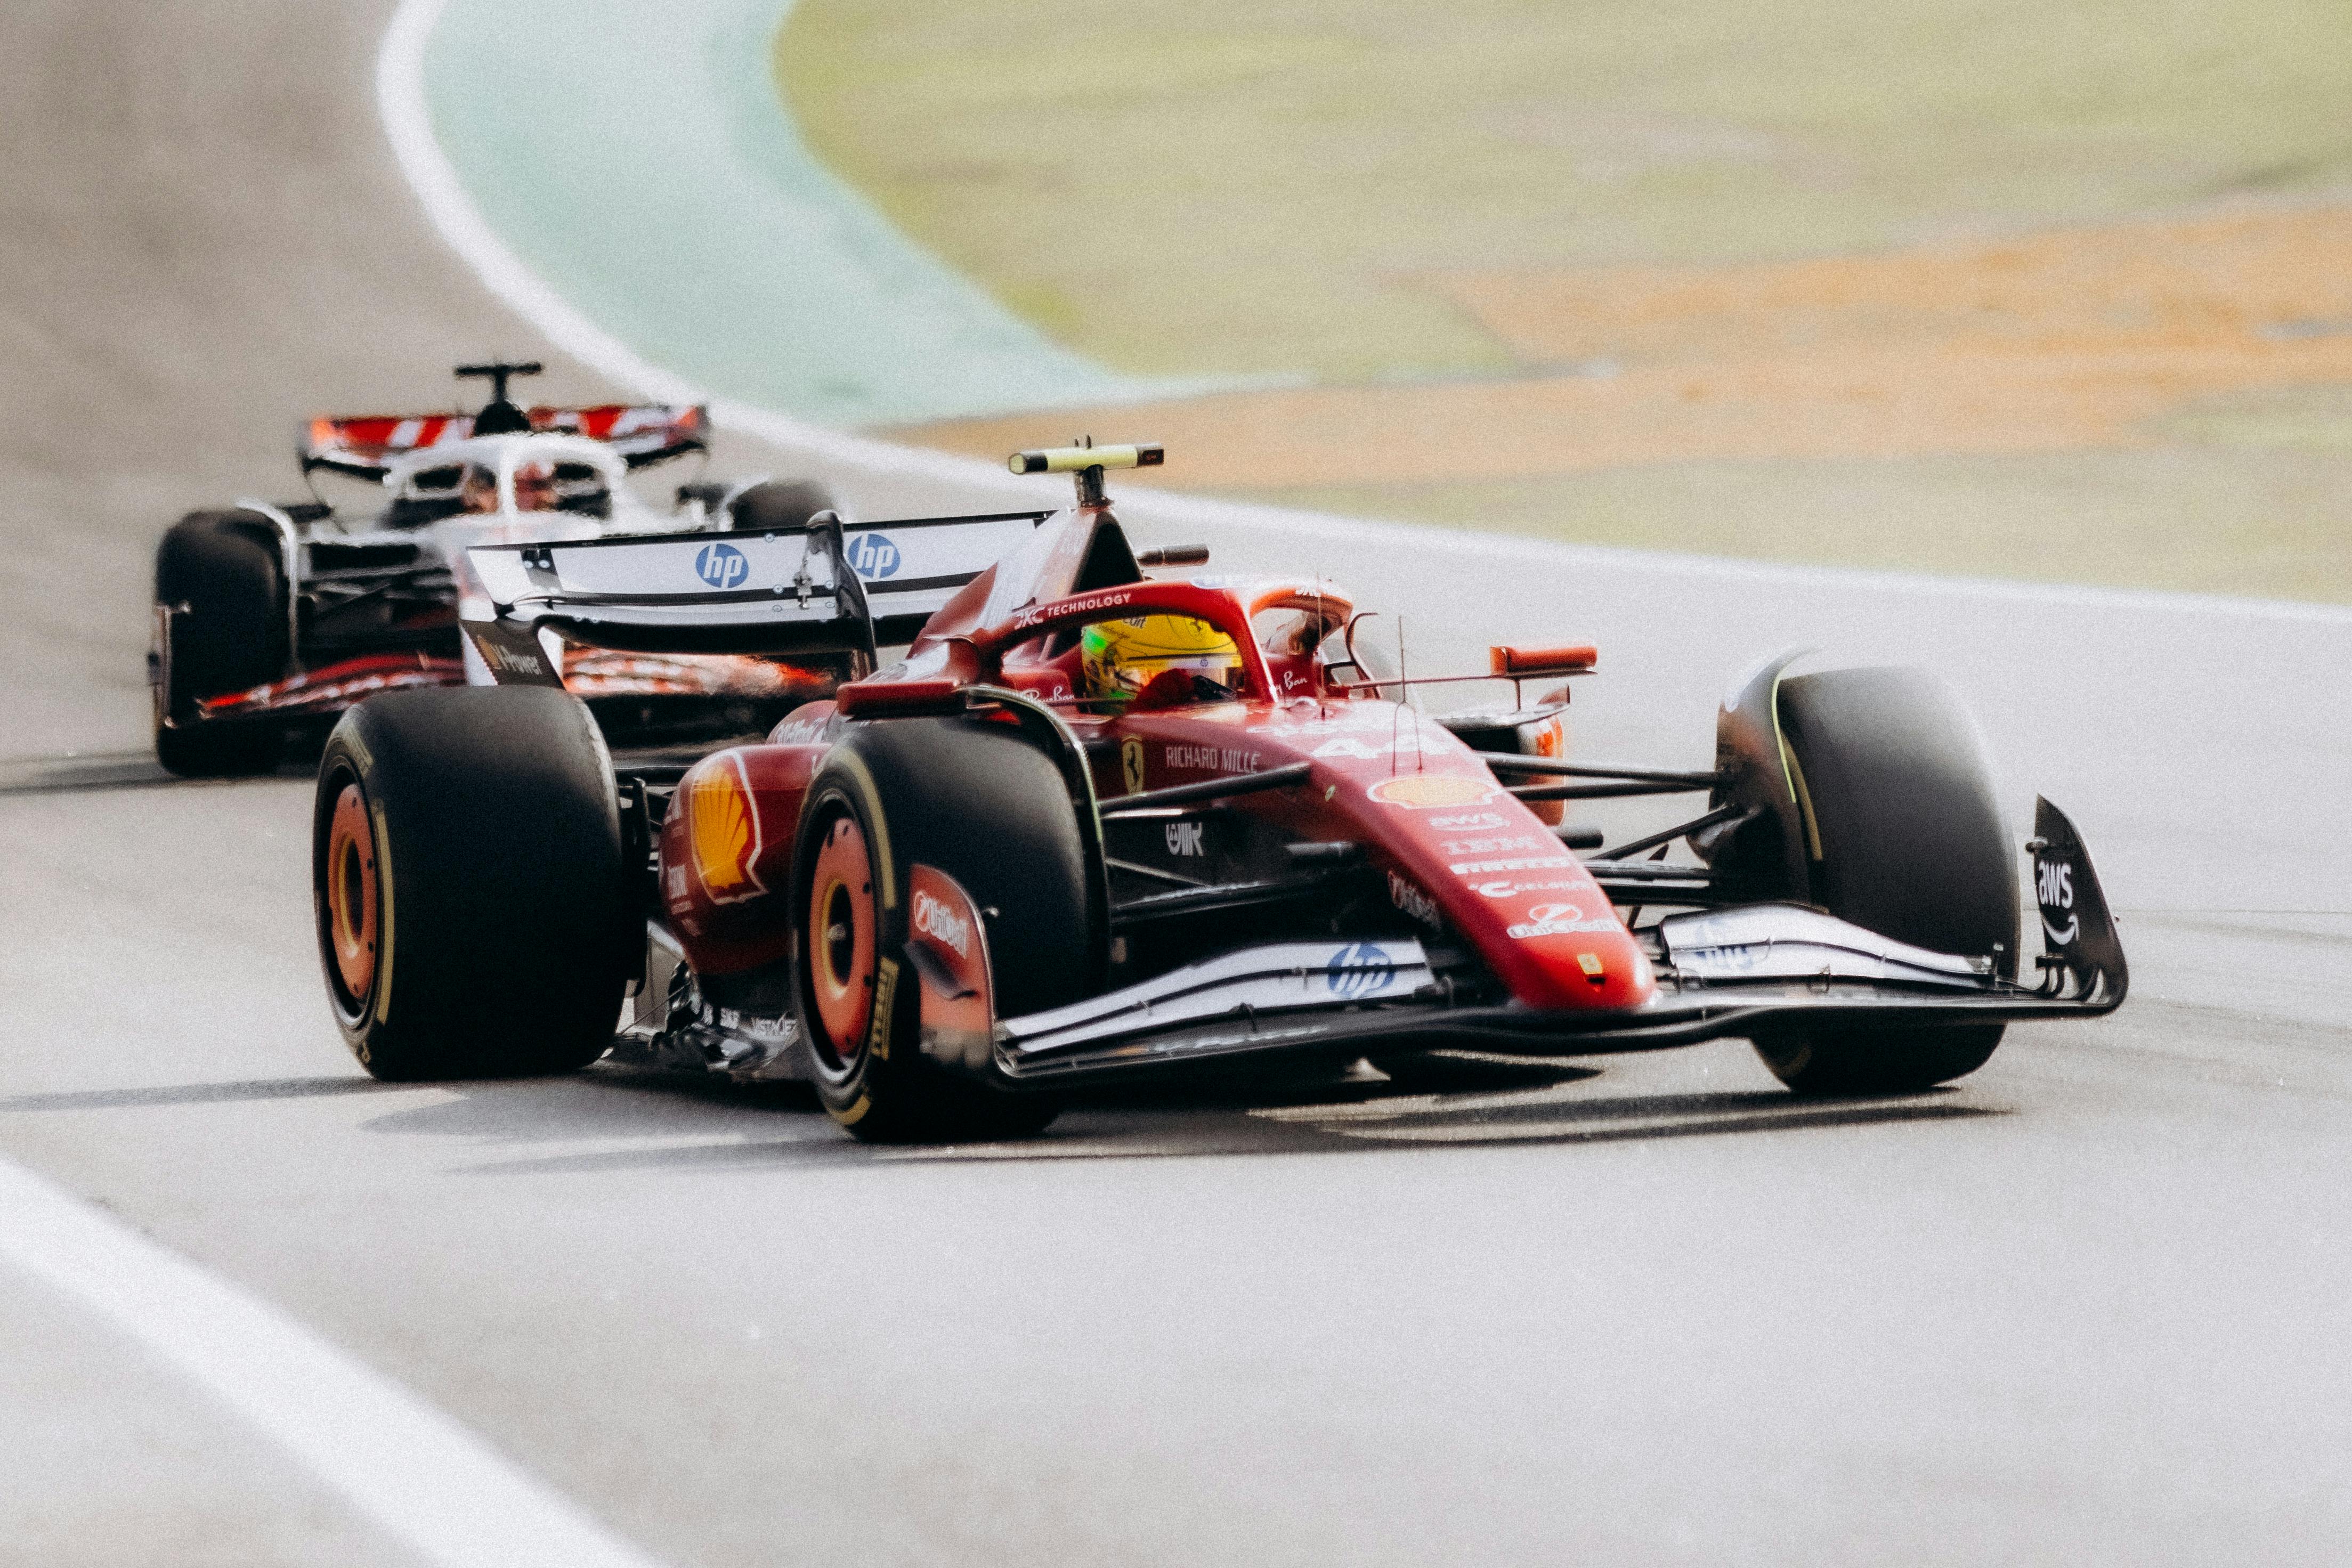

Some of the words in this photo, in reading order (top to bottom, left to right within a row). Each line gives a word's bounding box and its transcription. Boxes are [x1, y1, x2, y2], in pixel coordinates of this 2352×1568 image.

[703, 543, 743, 589] hp
[855, 533, 895, 579] hp
[1047, 593, 1131, 617] TECHNOLOGY
[1166, 746, 1218, 769] RICHARD
[1221, 749, 1262, 774] MILLE
[2039, 860, 2073, 909] aws
[1333, 944, 1389, 1000] hp
